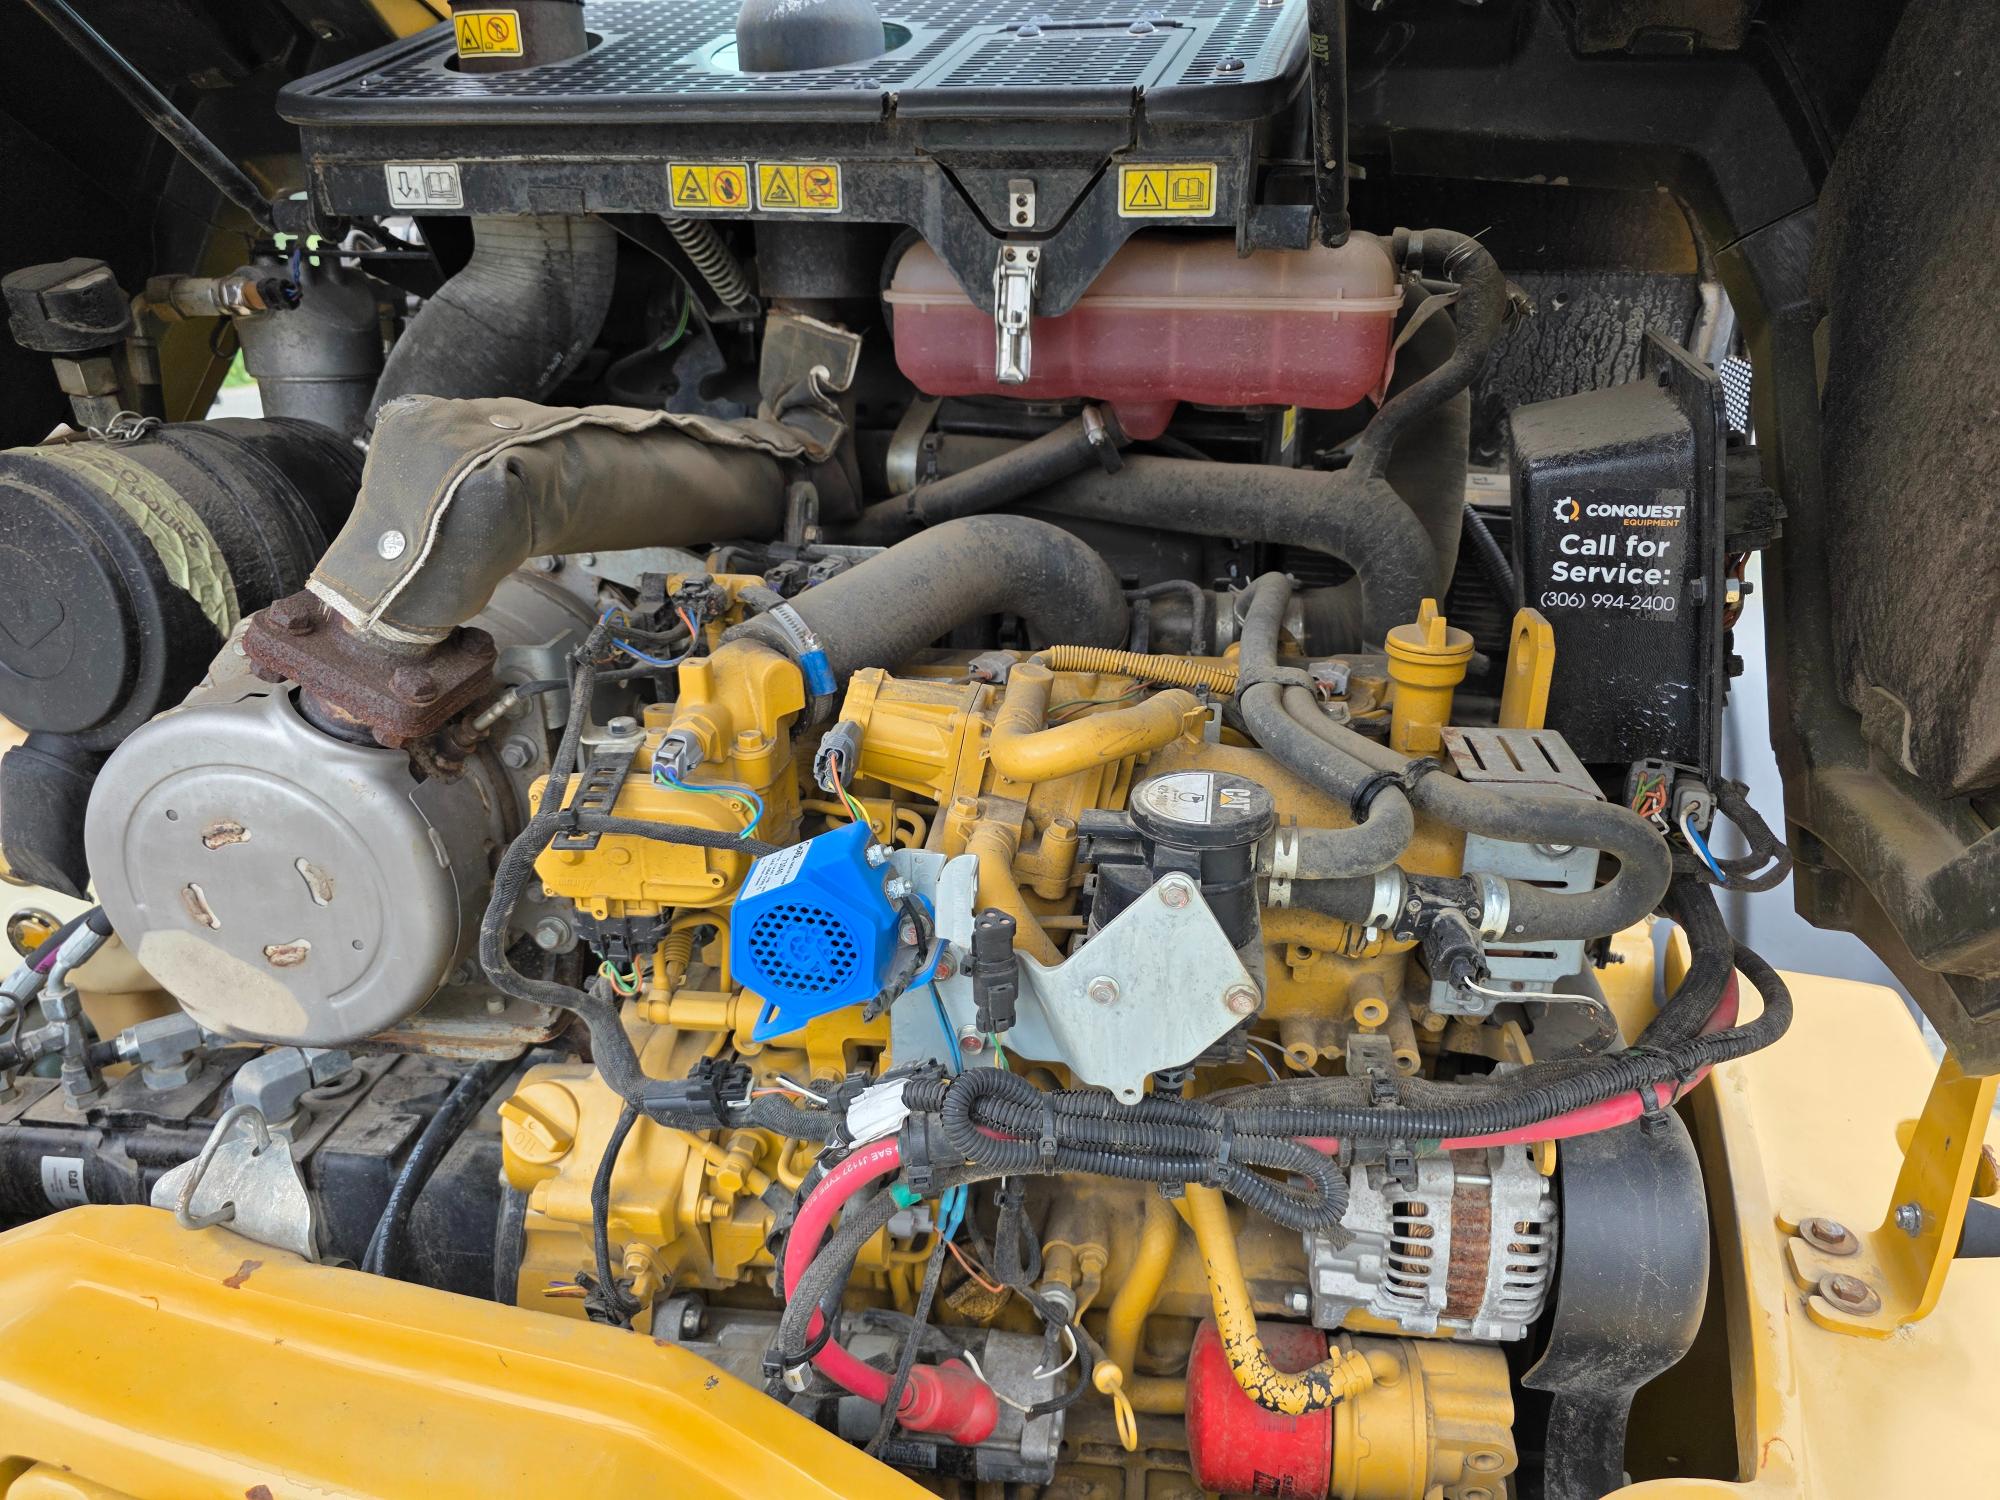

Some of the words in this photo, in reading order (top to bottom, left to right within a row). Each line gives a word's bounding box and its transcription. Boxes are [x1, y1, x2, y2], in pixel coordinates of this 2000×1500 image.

[1586, 504, 1685, 518] CONQUEST
[1623, 518, 1680, 527] EQUIPMENT
[1559, 533, 1616, 556] Call
[1625, 535, 1671, 558] for
[1550, 560, 1671, 586] Service:
[1540, 591, 1586, 609] (306)
[1591, 594, 1675, 611] 994-2400
[1219, 788, 1251, 811] CAT
[871, 1147, 893, 1161] SAE
[842, 1156, 869, 1176] J1127
[68, 1170, 80, 1193] CAT
[819, 1174, 841, 1195] TYPE
